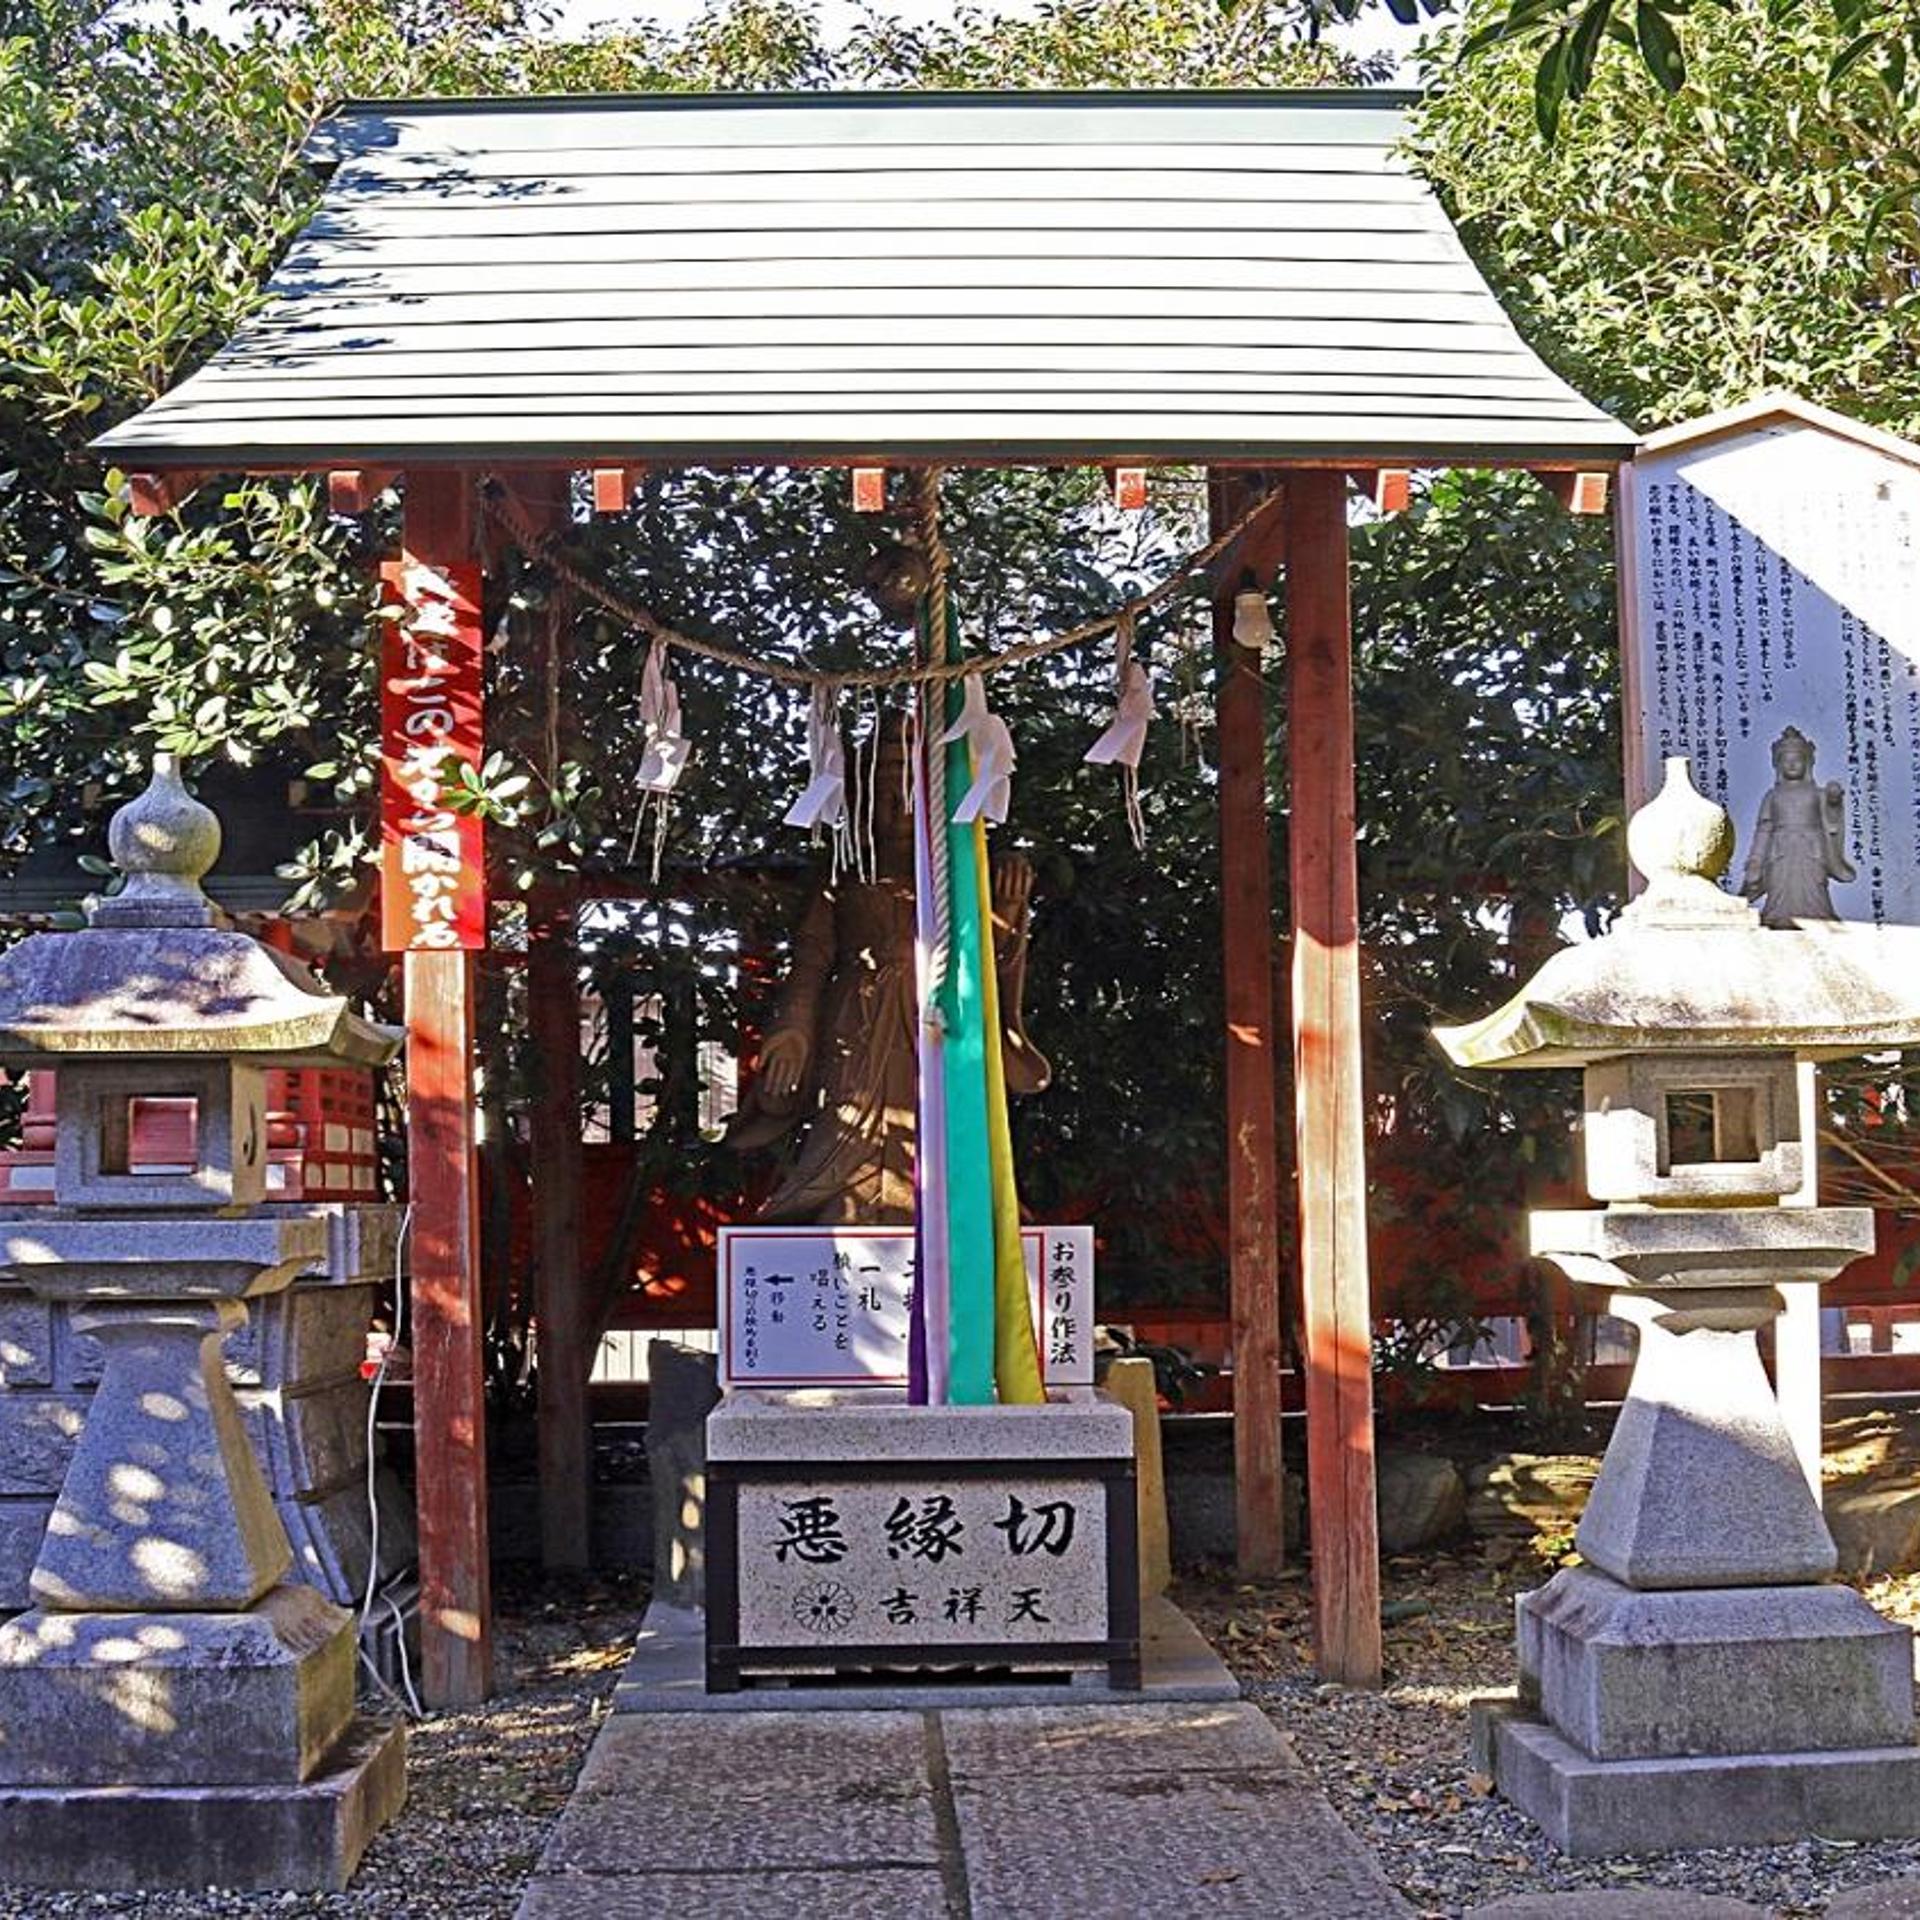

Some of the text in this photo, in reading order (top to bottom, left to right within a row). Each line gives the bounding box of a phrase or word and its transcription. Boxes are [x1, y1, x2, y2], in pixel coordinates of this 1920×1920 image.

[810, 1268, 830, 1332] 唱える
[857, 1265, 882, 1312] 一礼
[1050, 1241, 1077, 1365] お参り作法
[773, 1494, 1077, 1565] 悪縁切
[879, 1587, 1052, 1626] 吉祥天
